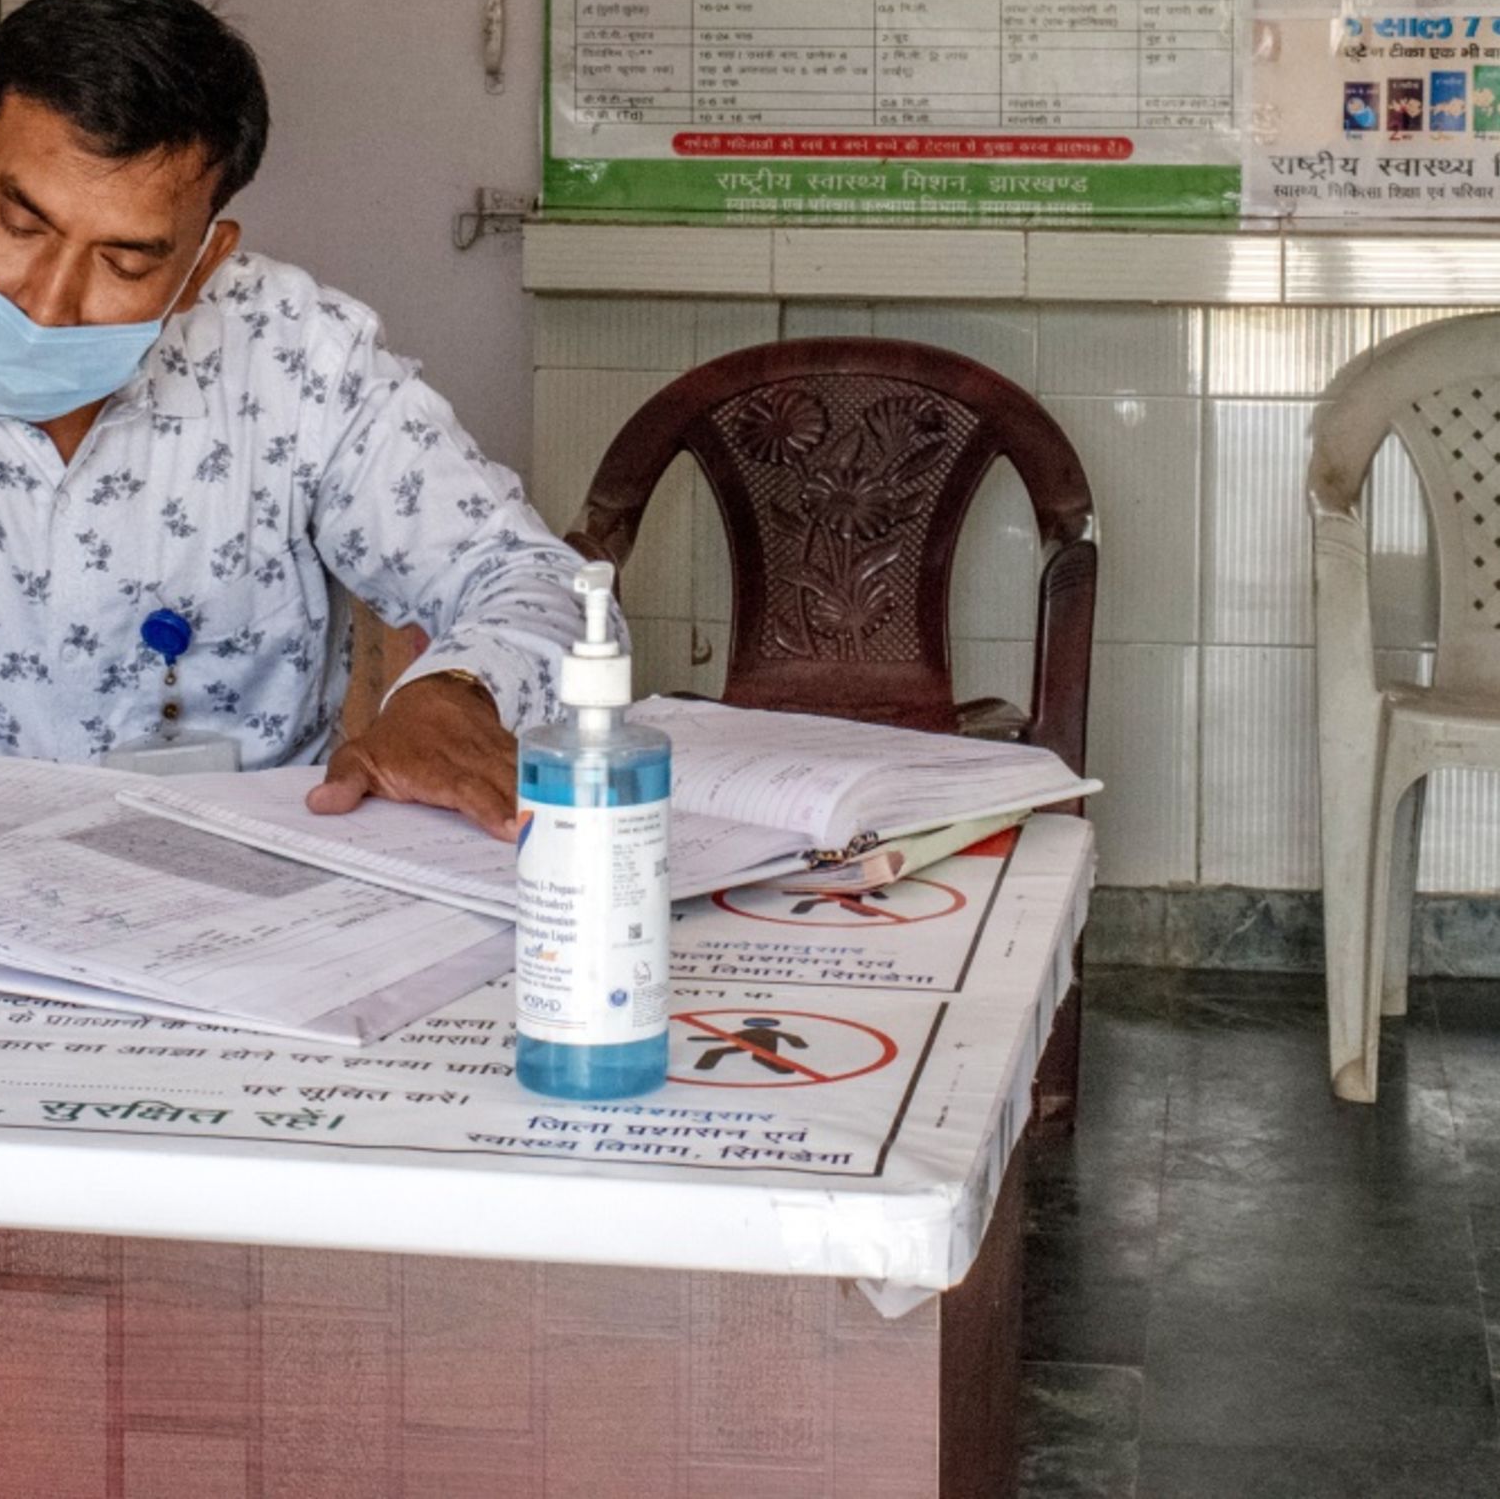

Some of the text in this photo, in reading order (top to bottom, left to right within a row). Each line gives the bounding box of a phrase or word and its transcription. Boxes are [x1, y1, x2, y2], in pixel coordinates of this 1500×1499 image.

[1463, 15, 1480, 40] 7
[1270, 150, 1359, 182] राष्ट्रीय
[1378, 158, 1474, 178] स्वास्थ्य
[715, 167, 1090, 196] राष्ट्रीय स्वास्थ्य झारखण्ड
[40, 1097, 231, 1128] सुरक्षित
[528, 1115, 808, 1145] जिला प्रशासन एवं
[720, 1145, 854, 1166] सिमडेगा
